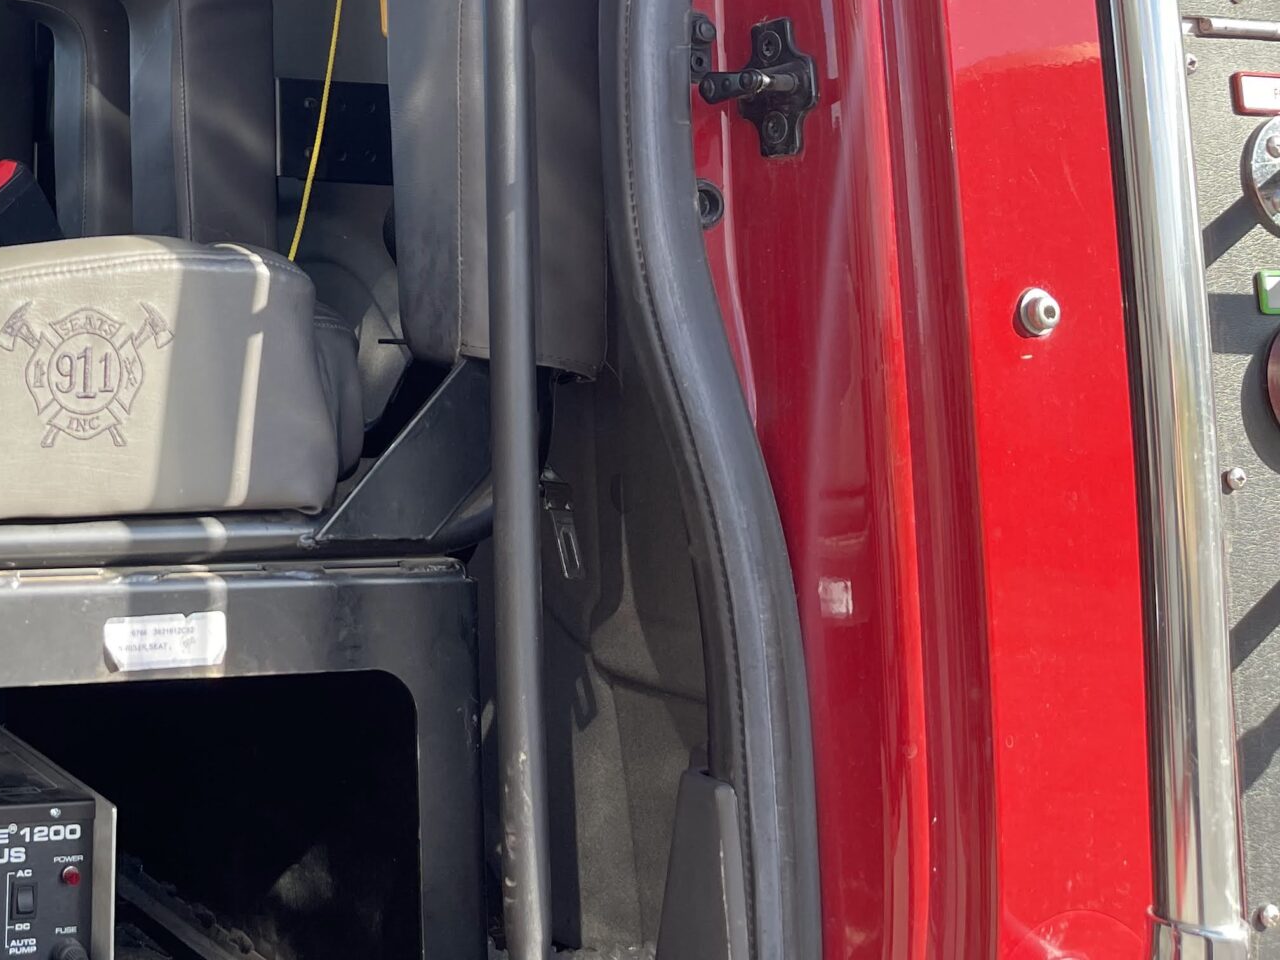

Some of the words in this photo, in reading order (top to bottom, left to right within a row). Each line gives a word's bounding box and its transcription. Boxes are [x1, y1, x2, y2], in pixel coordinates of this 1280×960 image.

[59, 314, 117, 335] SEATS
[55, 346, 114, 399] 911
[66, 416, 99, 432] INC
[20, 824, 81, 842] 1200
[53, 854, 83, 863] POWER
[16, 869, 32, 877] AC
[15, 923, 31, 931] DC
[55, 926, 78, 934] FUSE
[10, 938, 36, 947] AUTO
[9, 946, 37, 955] PUMP
